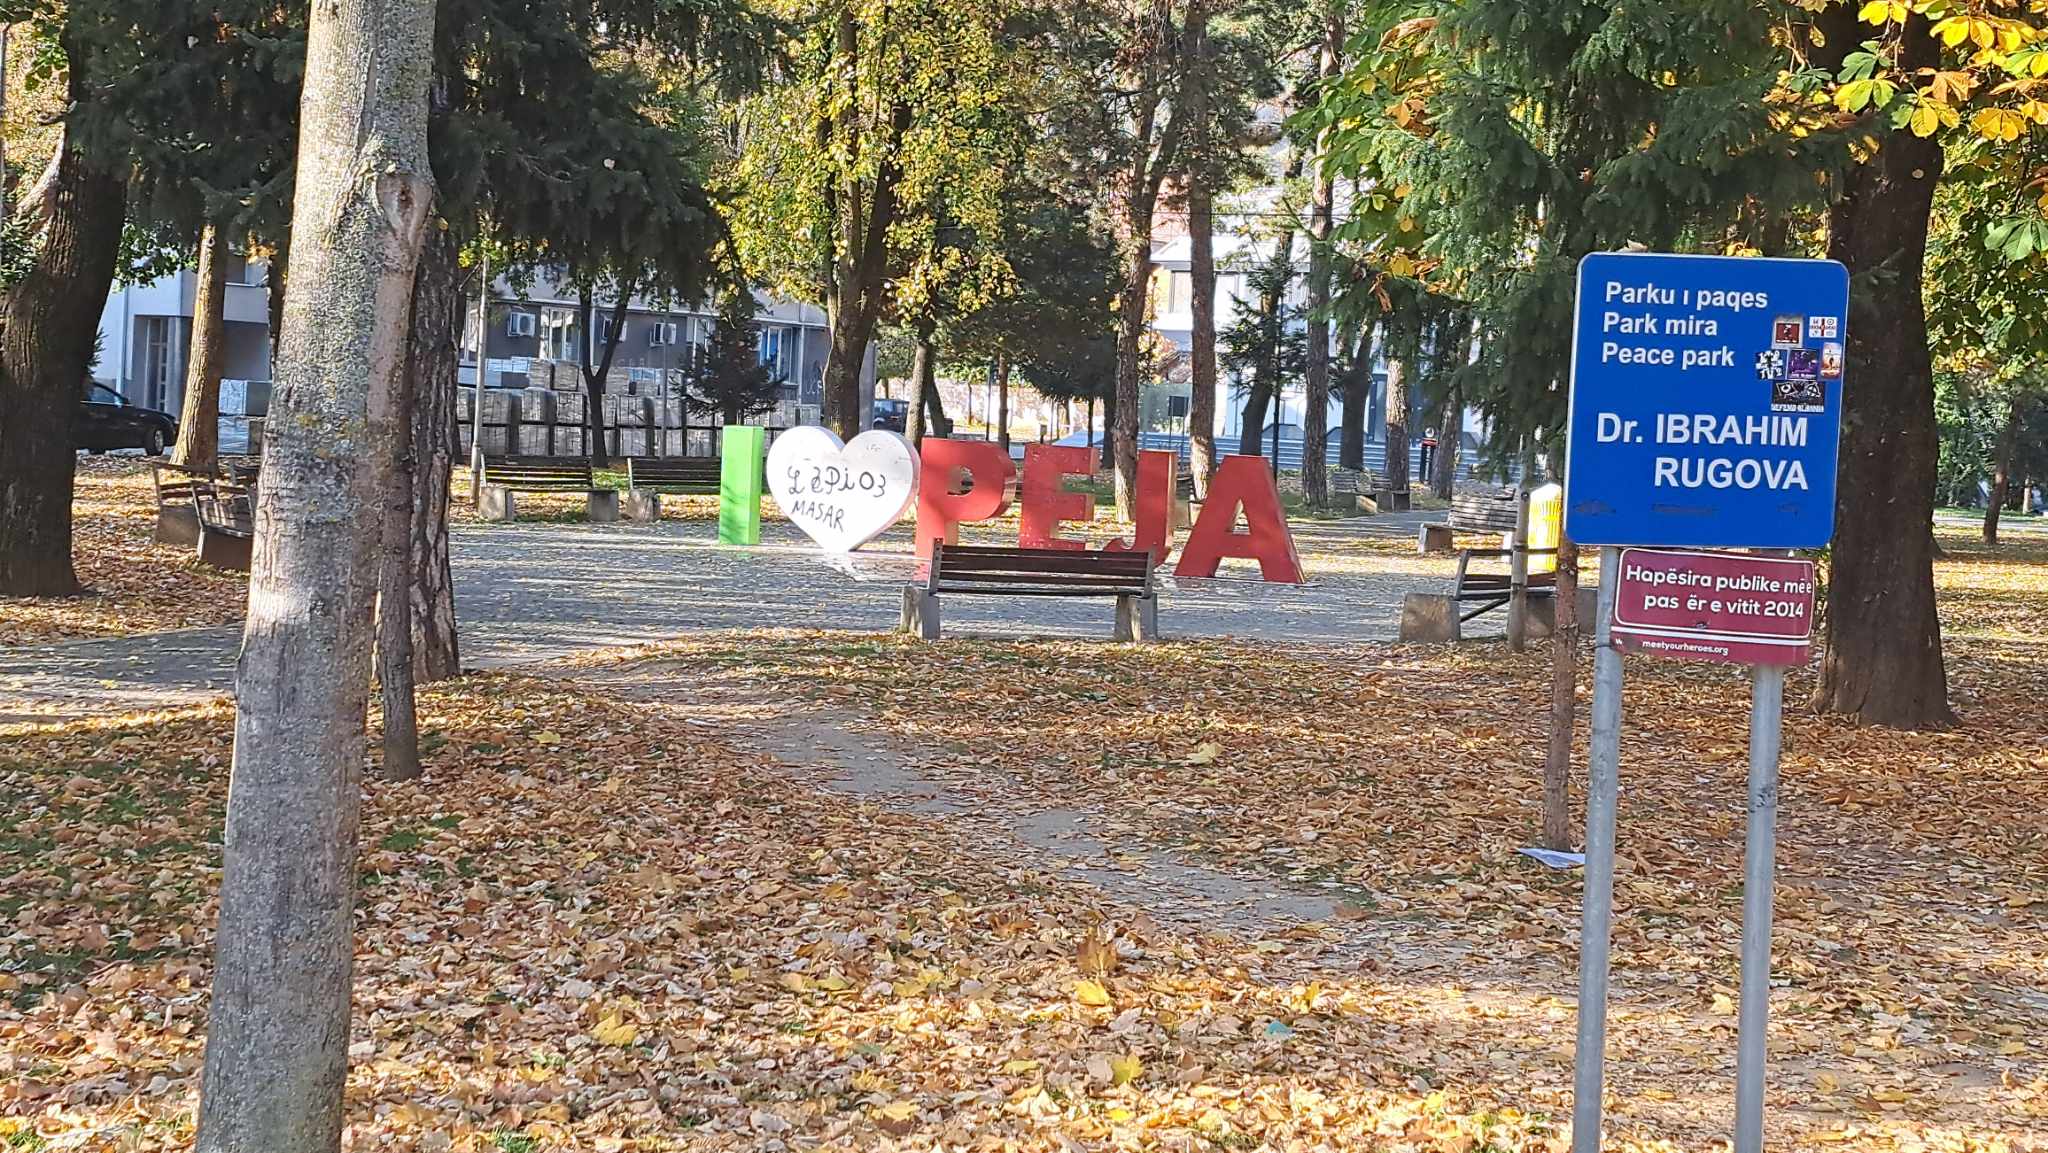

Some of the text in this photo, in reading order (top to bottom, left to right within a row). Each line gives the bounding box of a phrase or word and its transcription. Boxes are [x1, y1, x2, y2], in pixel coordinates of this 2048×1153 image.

[1605, 281, 1675, 305] Parku
[1696, 289, 1769, 312] paqes
[1603, 311, 1718, 337] Park mira
[1601, 342, 1675, 366] Peace
[1682, 345, 1735, 370] park
[1596, 412, 1808, 447] Dr. IBRAHIM
[1654, 457, 1809, 490] RUGOVA
[791, 499, 845, 533] MASAR
[913, 437, 1304, 584] PEJA
[1625, 564, 1712, 588] Hapësira
[1715, 574, 1780, 593] publike
[1710, 599, 1723, 613] e
[1726, 599, 1761, 616] vitit
[1763, 601, 1805, 618] 2014
[1642, 640, 1729, 656] meetyourheroes.org
